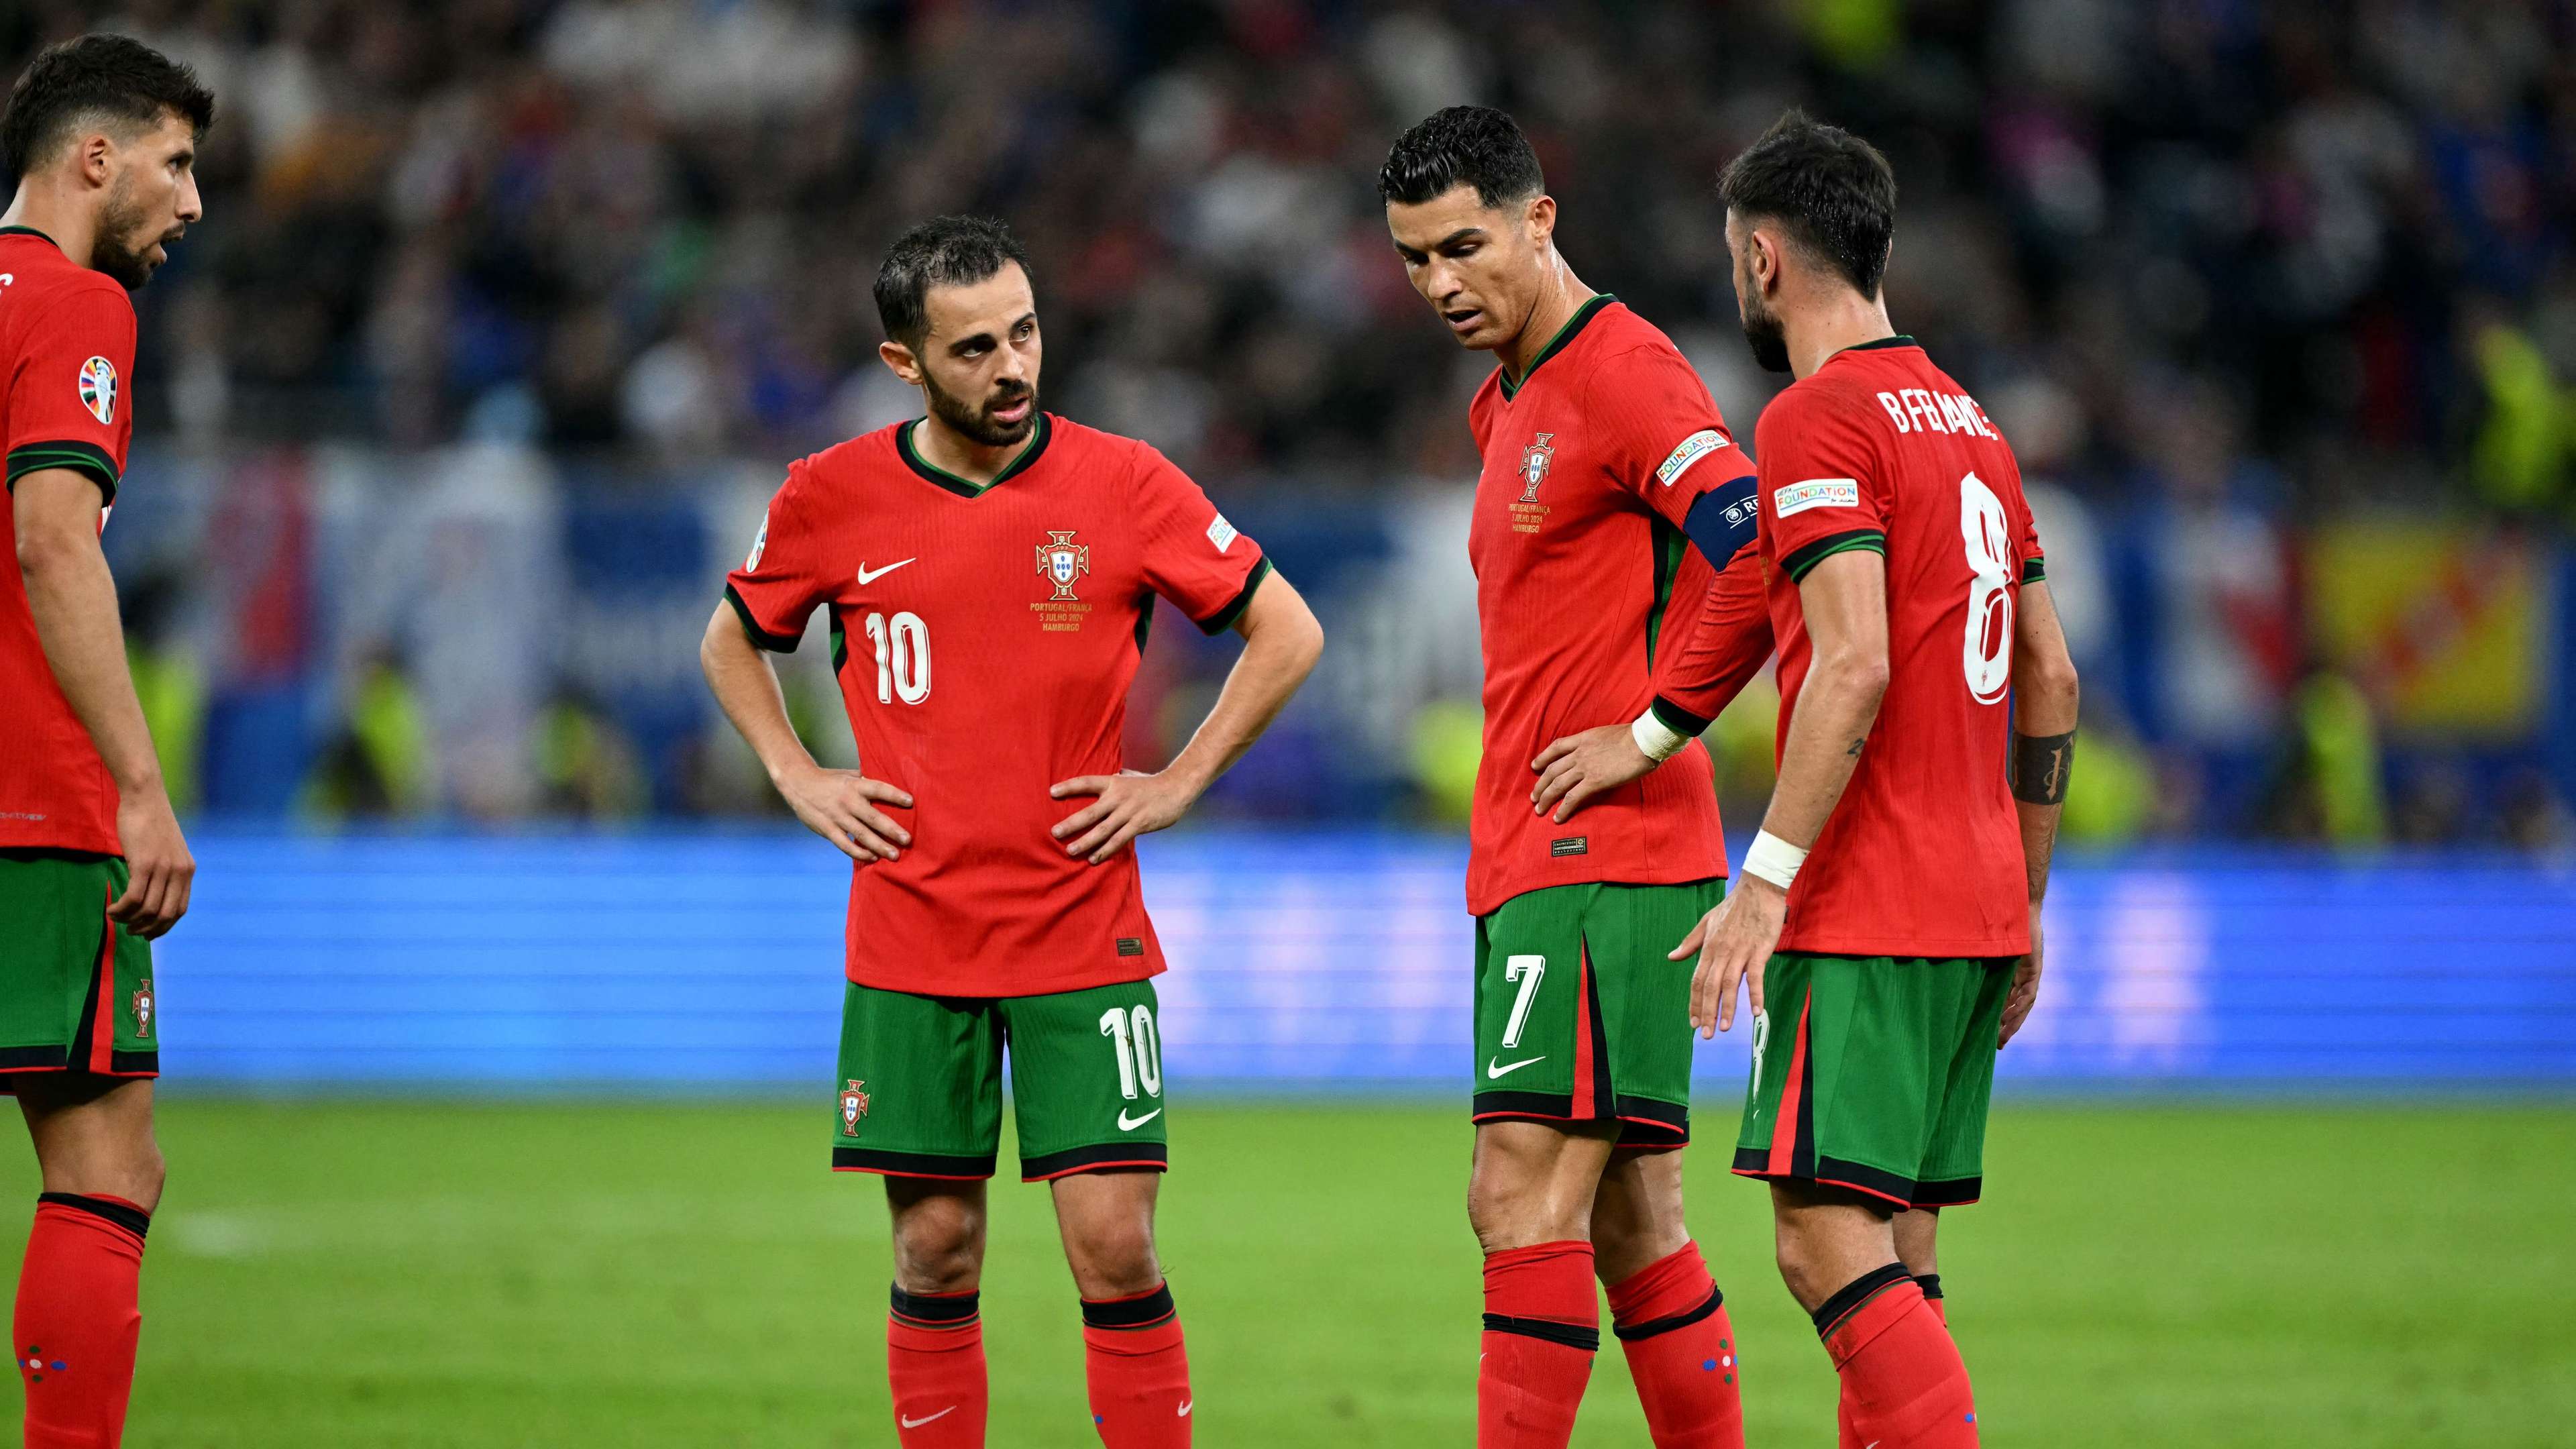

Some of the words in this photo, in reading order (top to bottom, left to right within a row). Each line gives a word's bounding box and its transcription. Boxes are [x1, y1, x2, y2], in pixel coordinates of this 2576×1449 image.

[1658, 435, 1722, 478] FOUNDATION
[1778, 487, 1856, 506] FOUNDATION
[1513, 525, 1540, 533] HAMBURGO
[1530, 515, 1543, 523] 2024
[1961, 471, 2012, 705] 8
[1030, 602, 1092, 612] PORTUGAL/FRANÇA
[1040, 613, 1044, 621] 5
[1045, 613, 1067, 622] JULHO
[865, 611, 931, 705] 10
[1501, 955, 1546, 1048] 7
[1099, 1004, 1161, 1100] 10
